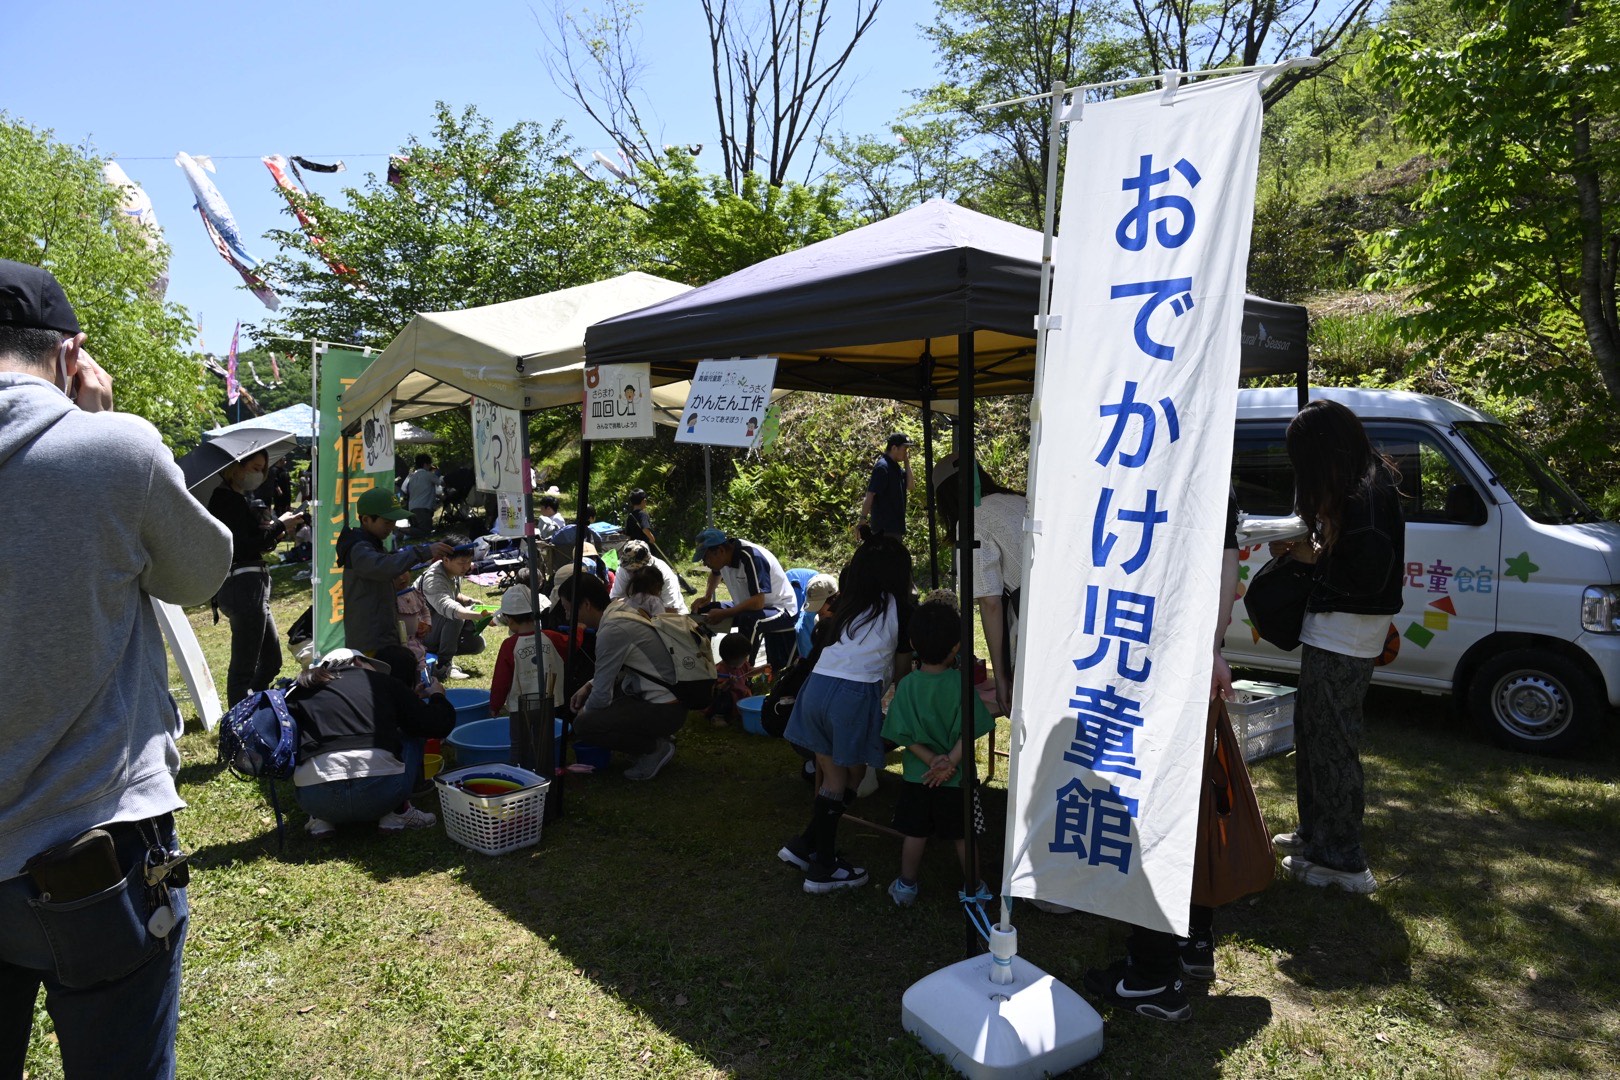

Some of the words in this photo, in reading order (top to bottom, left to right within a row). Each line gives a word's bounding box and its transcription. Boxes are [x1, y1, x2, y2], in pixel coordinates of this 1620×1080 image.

[1241, 331, 1258, 346] tural
[1264, 335, 1291, 351] Season
[592, 388, 615, 399] さらまわ
[742, 384, 767, 393] こうさく
[591, 399, 629, 418] 皿回し
[690, 394, 765, 412] かんたん工作
[1048, 154, 1202, 875] おでかけ児童館
[1402, 558, 1494, 594] 児童館
